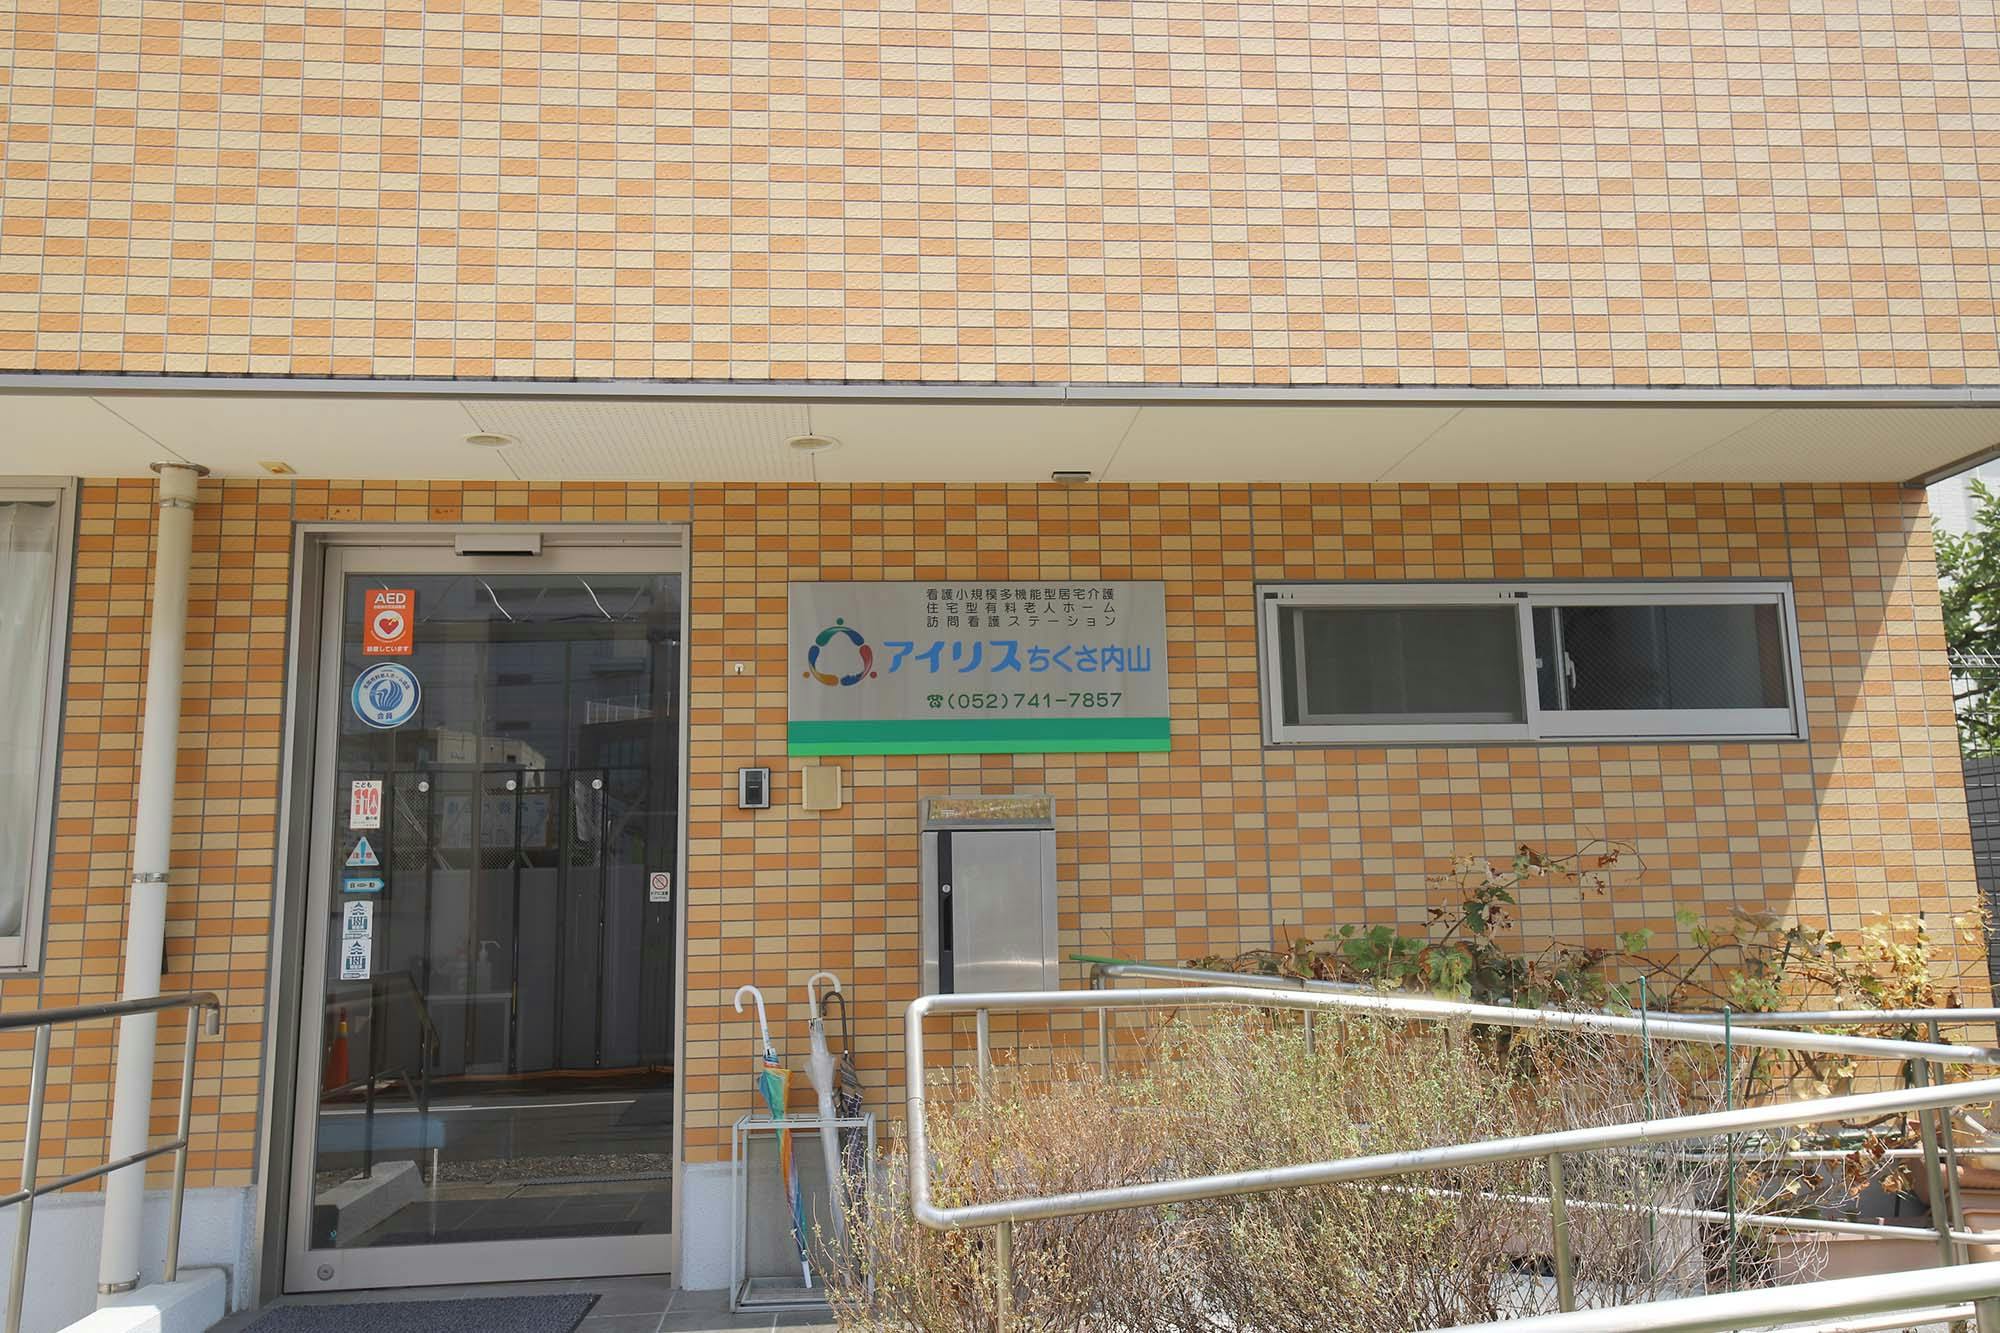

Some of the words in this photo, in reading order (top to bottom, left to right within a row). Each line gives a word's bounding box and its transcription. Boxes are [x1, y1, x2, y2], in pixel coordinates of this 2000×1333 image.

[374, 592, 407, 604] AED
[926, 588, 1115, 601] 看護小規模多機能型居宅介護
[926, 602, 1116, 614] 住宅型有料老人ホーム
[926, 615, 1116, 628] 訪問看護ステーション
[883, 640, 1152, 673] アイリスちくさ内山
